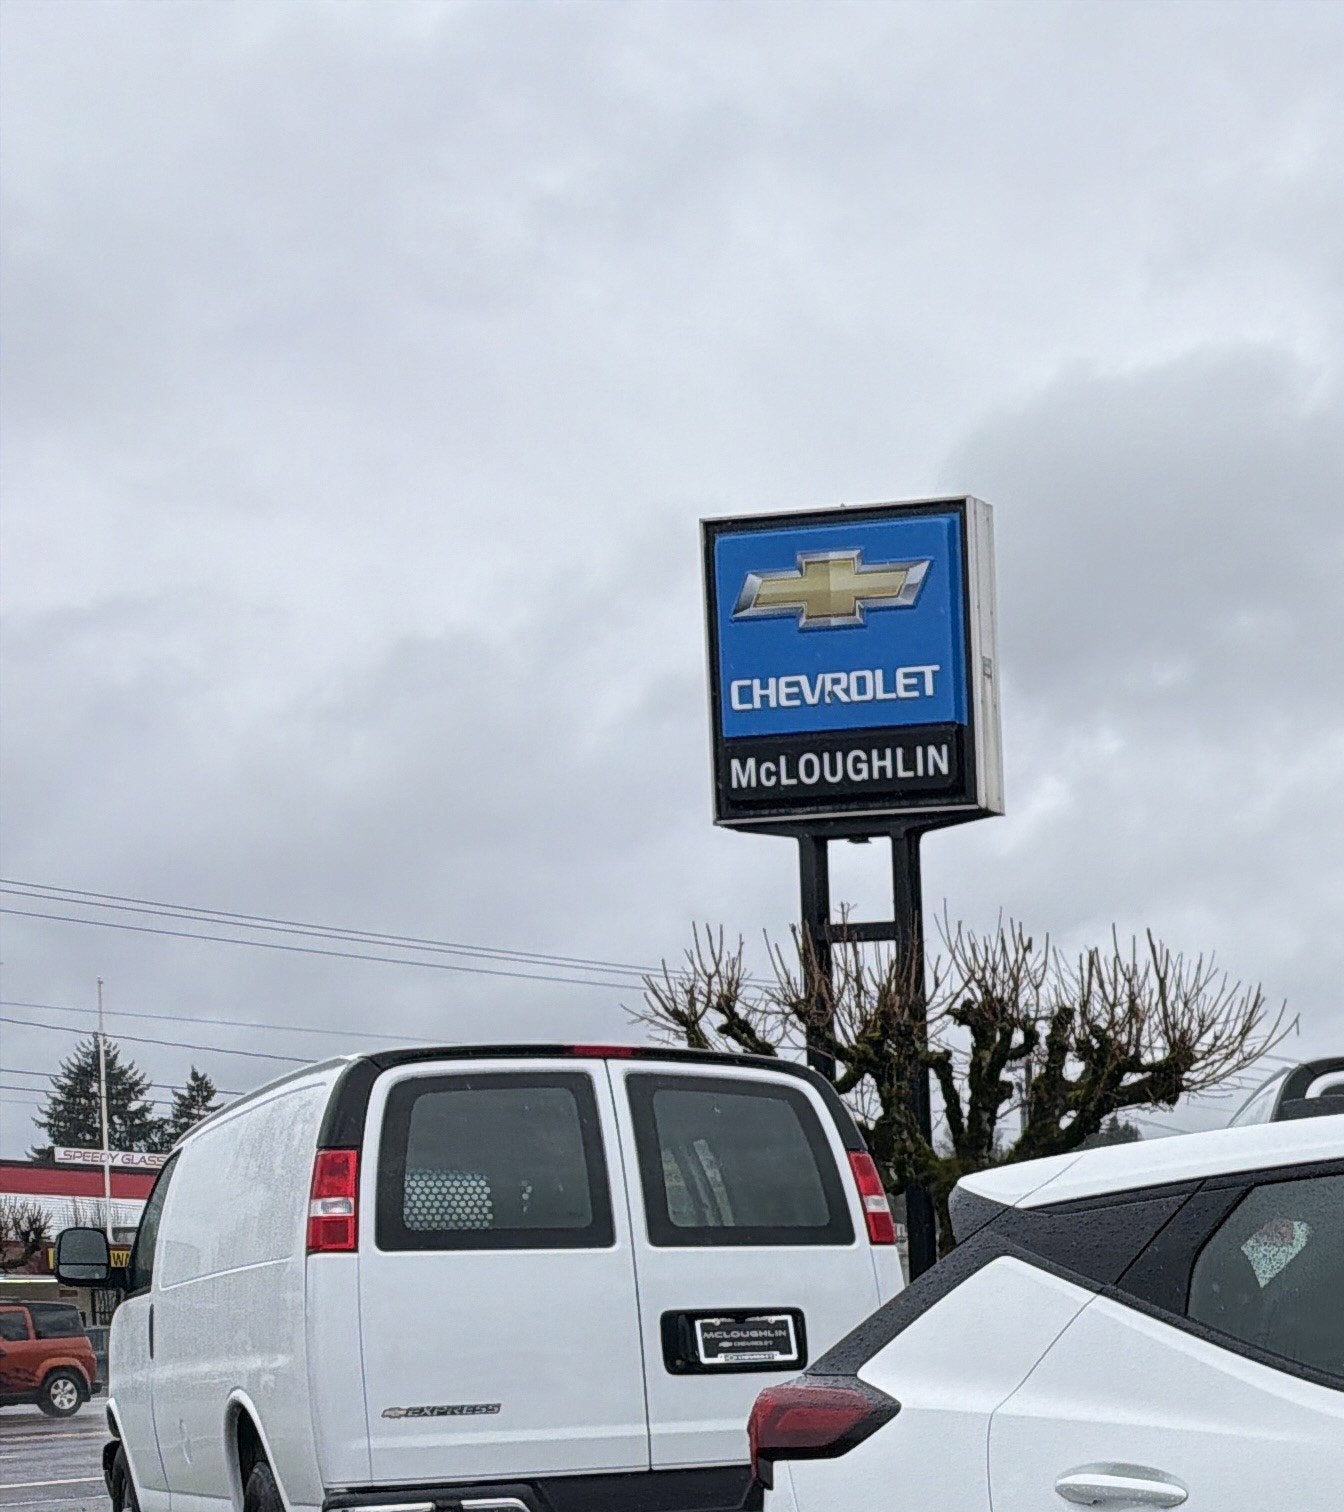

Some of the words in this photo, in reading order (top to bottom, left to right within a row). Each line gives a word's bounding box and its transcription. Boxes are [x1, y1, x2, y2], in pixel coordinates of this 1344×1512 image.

[730, 664, 941, 711] CHEVROLET
[730, 744, 950, 789] McLOUGHLIN
[57, 1149, 119, 1163] SPEEDY
[121, 1153, 167, 1167] GLASS
[703, 1329, 787, 1339] MCLOUGHLIN
[406, 1403, 501, 1417] EXPRESS
